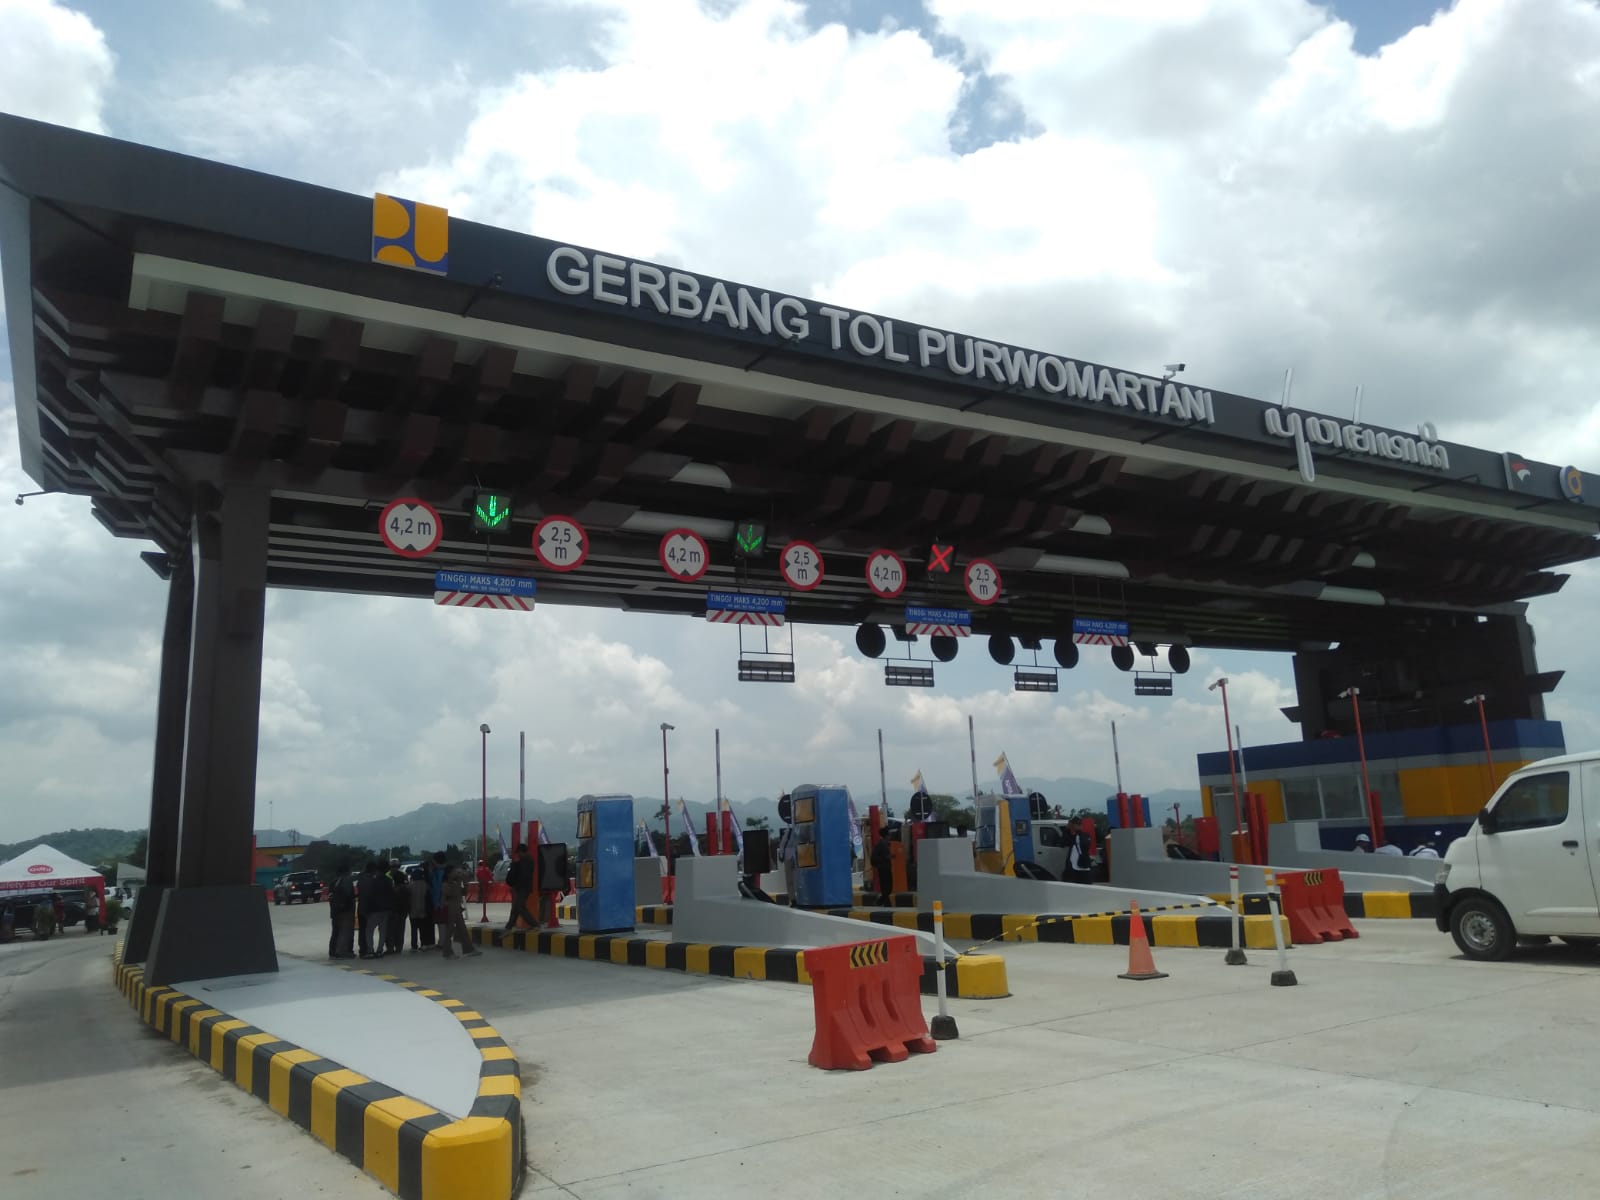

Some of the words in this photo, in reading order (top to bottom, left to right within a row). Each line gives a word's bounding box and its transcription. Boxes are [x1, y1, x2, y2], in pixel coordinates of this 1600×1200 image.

[546, 247, 809, 341] GERBANG
[819, 306, 910, 363] TOL
[918, 328, 1215, 424] PURWOMARTANI
[390, 516, 414, 536] 4,2
[417, 520, 432, 536] m
[551, 526, 572, 544] 2,5
[554, 546, 568, 560] m
[668, 546, 687, 563] 4,2
[689, 551, 701, 563] m
[793, 550, 810, 566] 2,5
[440, 573, 467, 584] TINGGI
[470, 575, 491, 586] MAKS
[518, 580, 533, 588] mm
[797, 568, 808, 581] m
[873, 567, 889, 582] 4,2
[891, 569, 900, 581] m
[975, 568, 990, 582] 2,5
[979, 584, 989, 596] m
